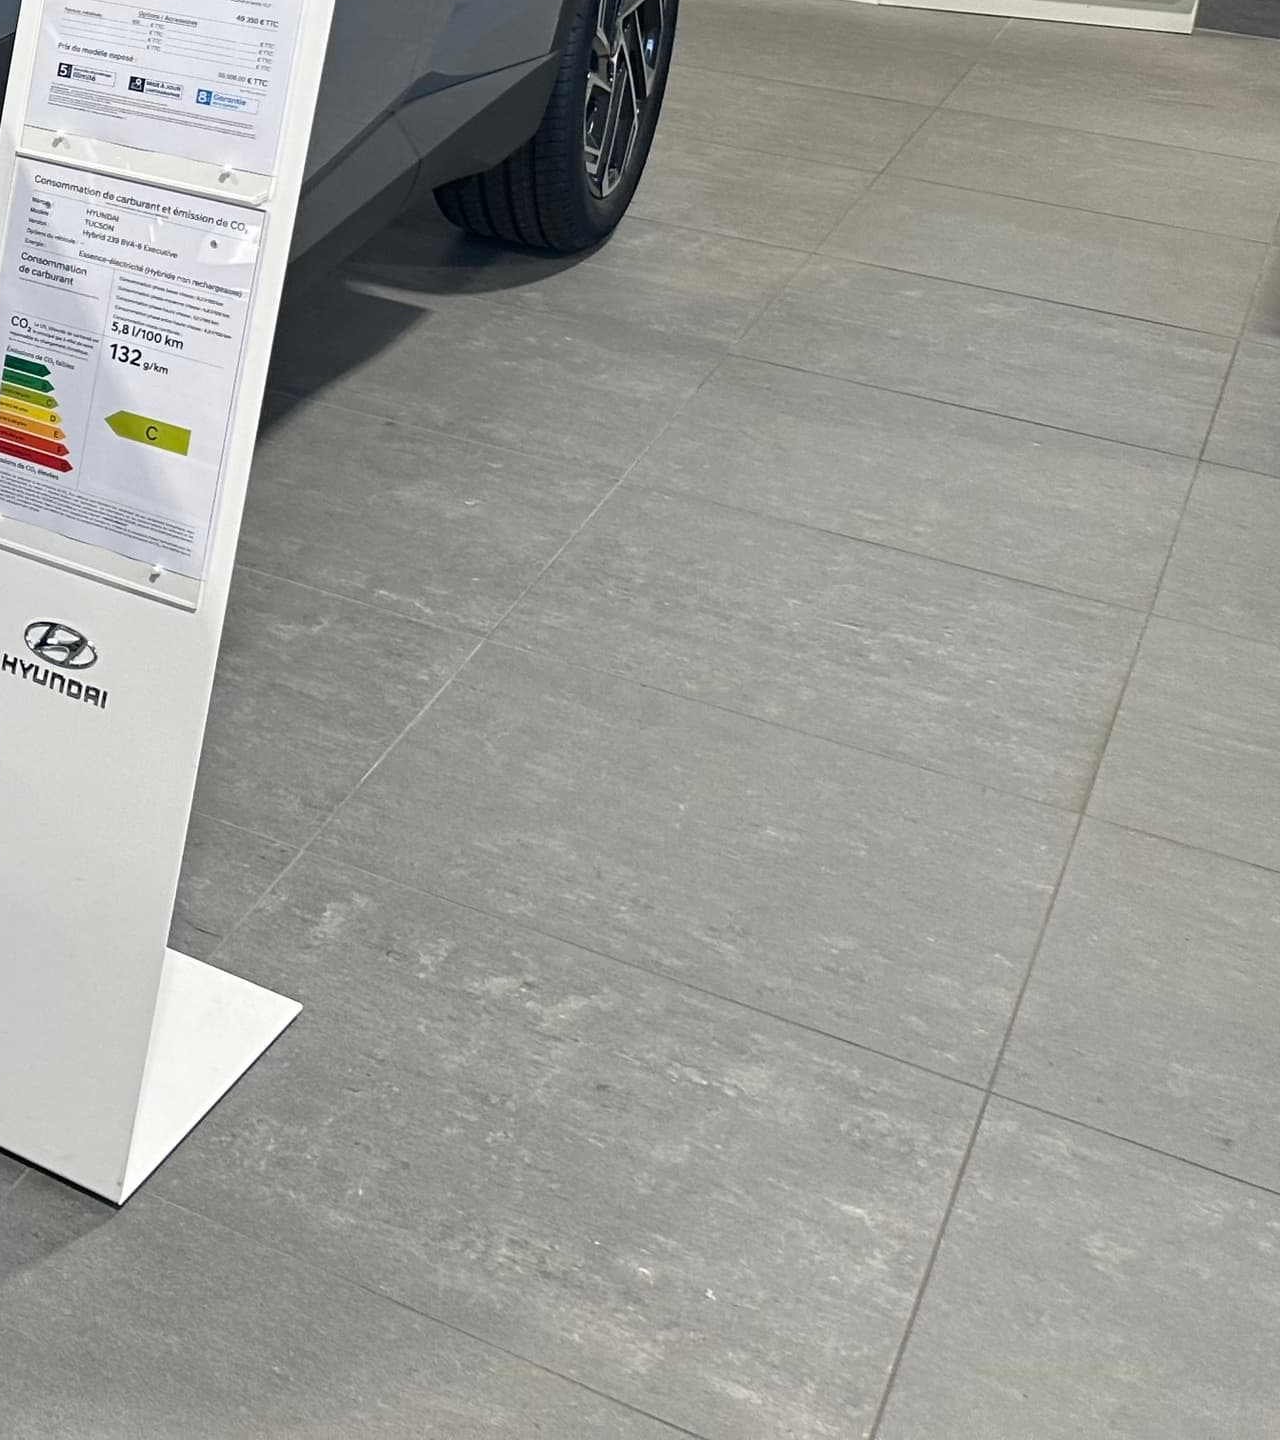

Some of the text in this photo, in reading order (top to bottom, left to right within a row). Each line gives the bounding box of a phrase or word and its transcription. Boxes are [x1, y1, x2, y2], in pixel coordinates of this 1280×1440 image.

[265, 19, 279, 27] TTC
[57, 41, 70, 50] Prix
[81, 46, 107, 57] modèle
[59, 64, 68, 76] 5
[253, 78, 268, 87] TTC
[197, 90, 207, 102] 8
[34, 174, 101, 197] Consommation
[102, 190, 114, 200] de
[115, 193, 160, 211] carburant
[161, 205, 171, 214] et
[172, 206, 214, 224] émission
[215, 216, 228, 228] de
[85, 208, 119, 222] HYUNDAI
[84, 218, 114, 232] TUCSON
[82, 229, 105, 242] Hybrid
[143, 244, 178, 258] Executive
[20, 251, 87, 276] Consommation
[18, 263, 73, 285] de carburant
[144, 266, 175, 281] (Hybride
[176, 276, 190, 284] non
[110, 320, 130, 336] 5,8
[131, 325, 162, 344] l/100
[164, 334, 184, 350] km
[108, 342, 168, 376] 132 g/km
[45, 397, 52, 407] C
[49, 414, 56, 423] D
[53, 430, 59, 438] E
[144, 424, 158, 441] C
[1, 652, 109, 710] HYUNDAI
